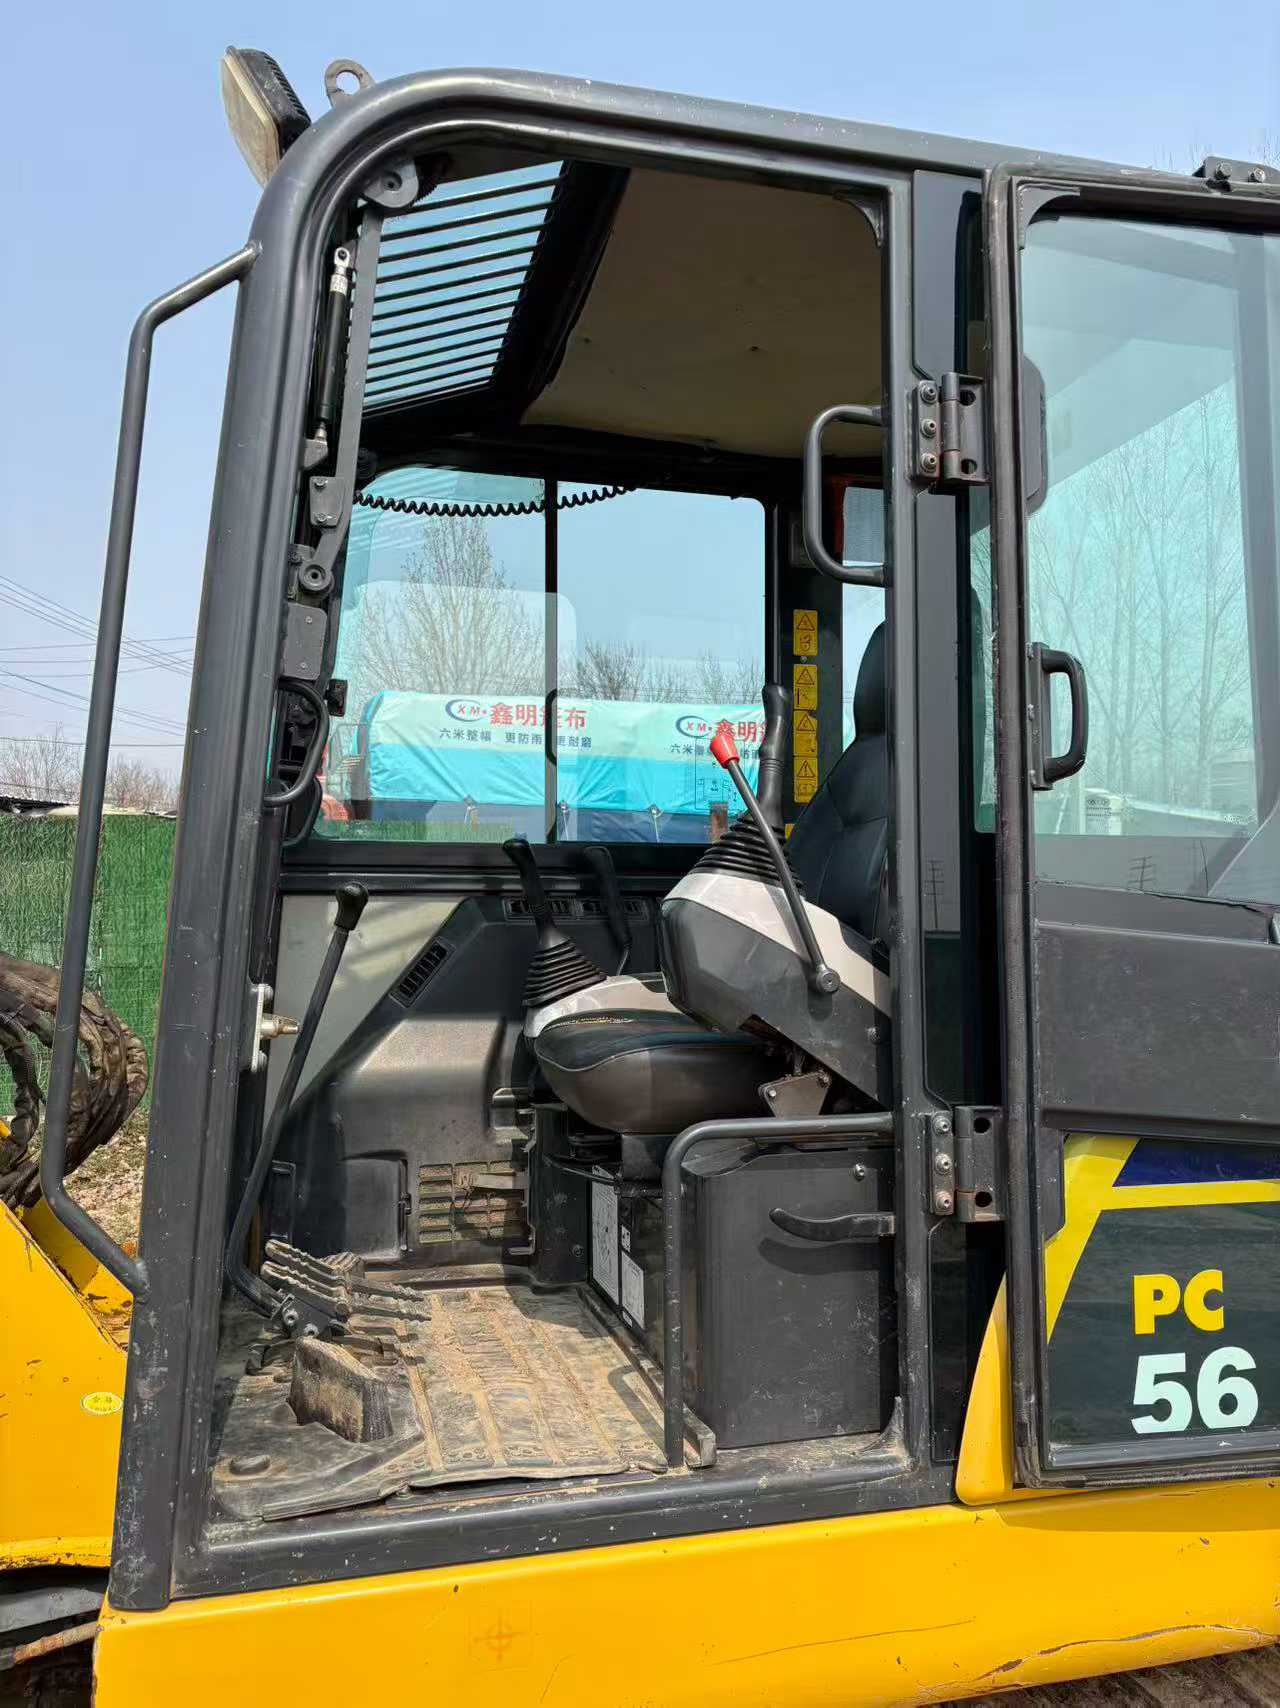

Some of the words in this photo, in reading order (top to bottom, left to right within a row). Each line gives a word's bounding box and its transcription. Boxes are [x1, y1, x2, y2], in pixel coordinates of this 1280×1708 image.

[715, 718, 766, 743] 鑫明
[1133, 1269, 1225, 1335] PC
[1131, 1346, 1259, 1434] 56
